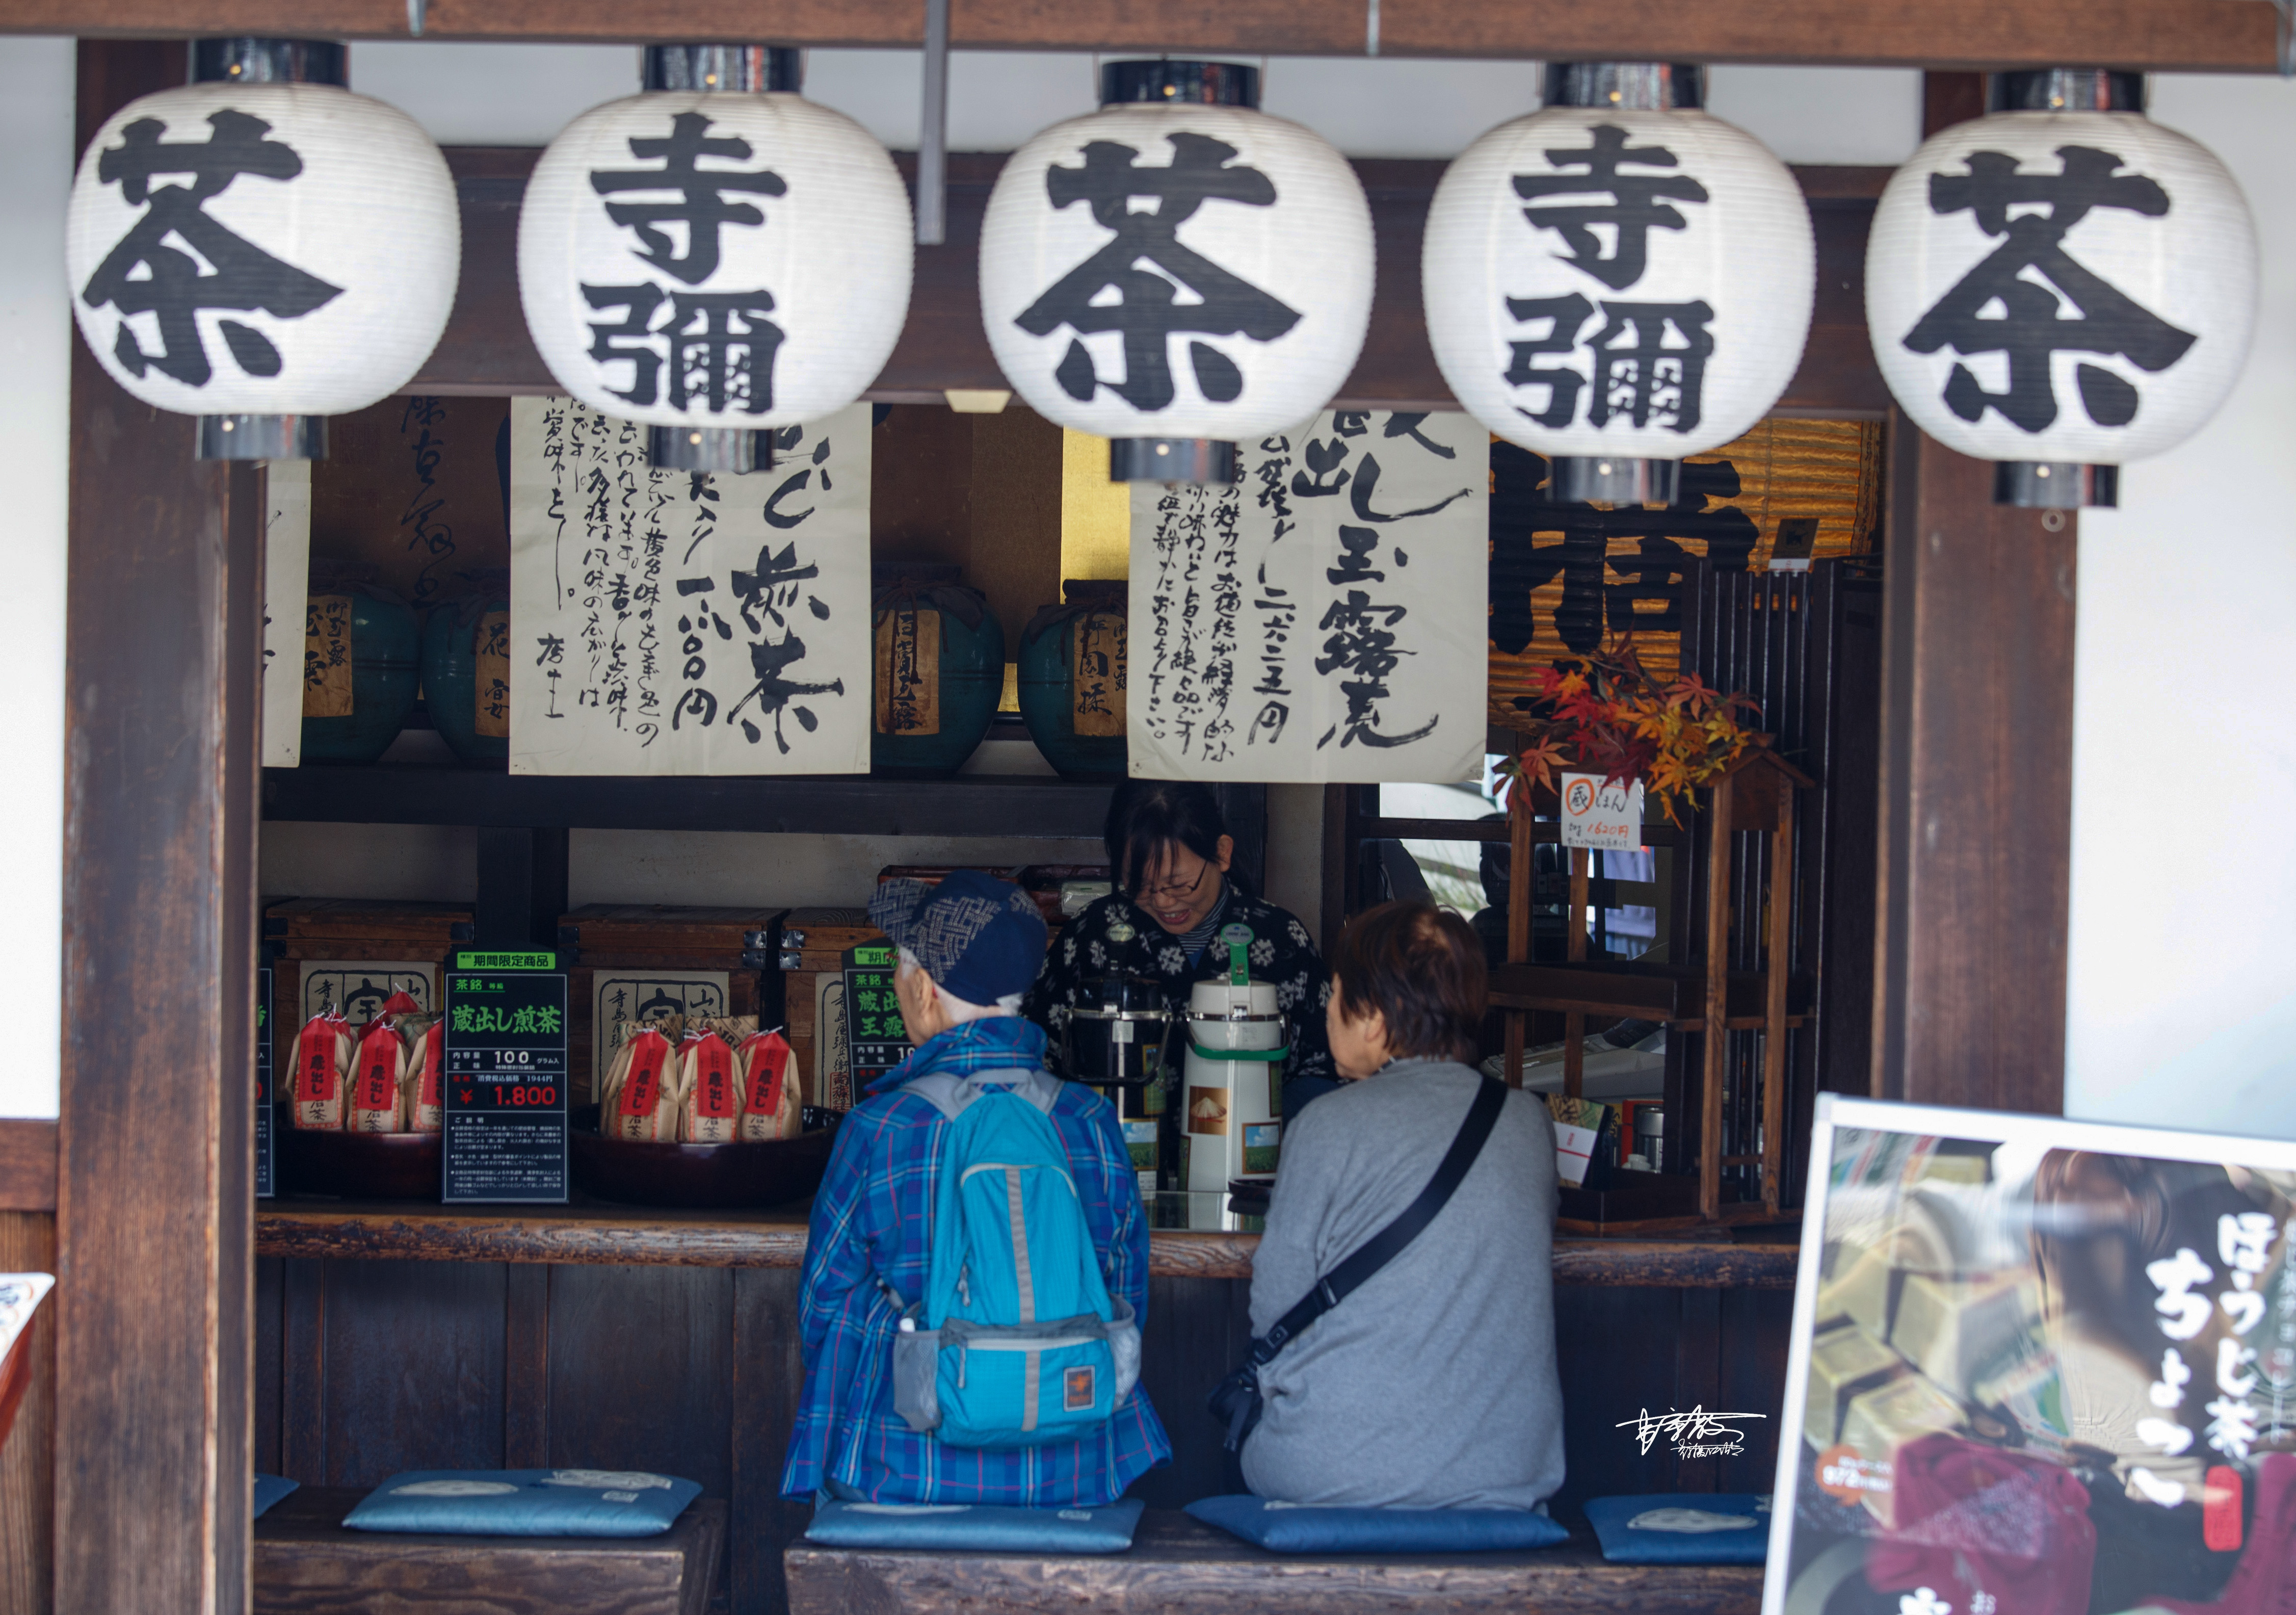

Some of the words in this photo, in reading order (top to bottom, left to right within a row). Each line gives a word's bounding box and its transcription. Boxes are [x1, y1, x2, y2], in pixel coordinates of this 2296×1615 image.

[83, 108, 348, 388] 茶
[579, 110, 788, 415] 寺彌
[1014, 132, 1303, 413] 茶
[1503, 122, 1717, 434] 寺彌
[1901, 144, 2200, 433] 茶
[452, 1004, 562, 1034] 蔵出し煎茶
[456, 979, 482, 991] 茶銘
[473, 955, 549, 967] 期間限定商品
[494, 1051, 529, 1063] 100
[2205, 1212, 2278, 1460] ほうじ茶
